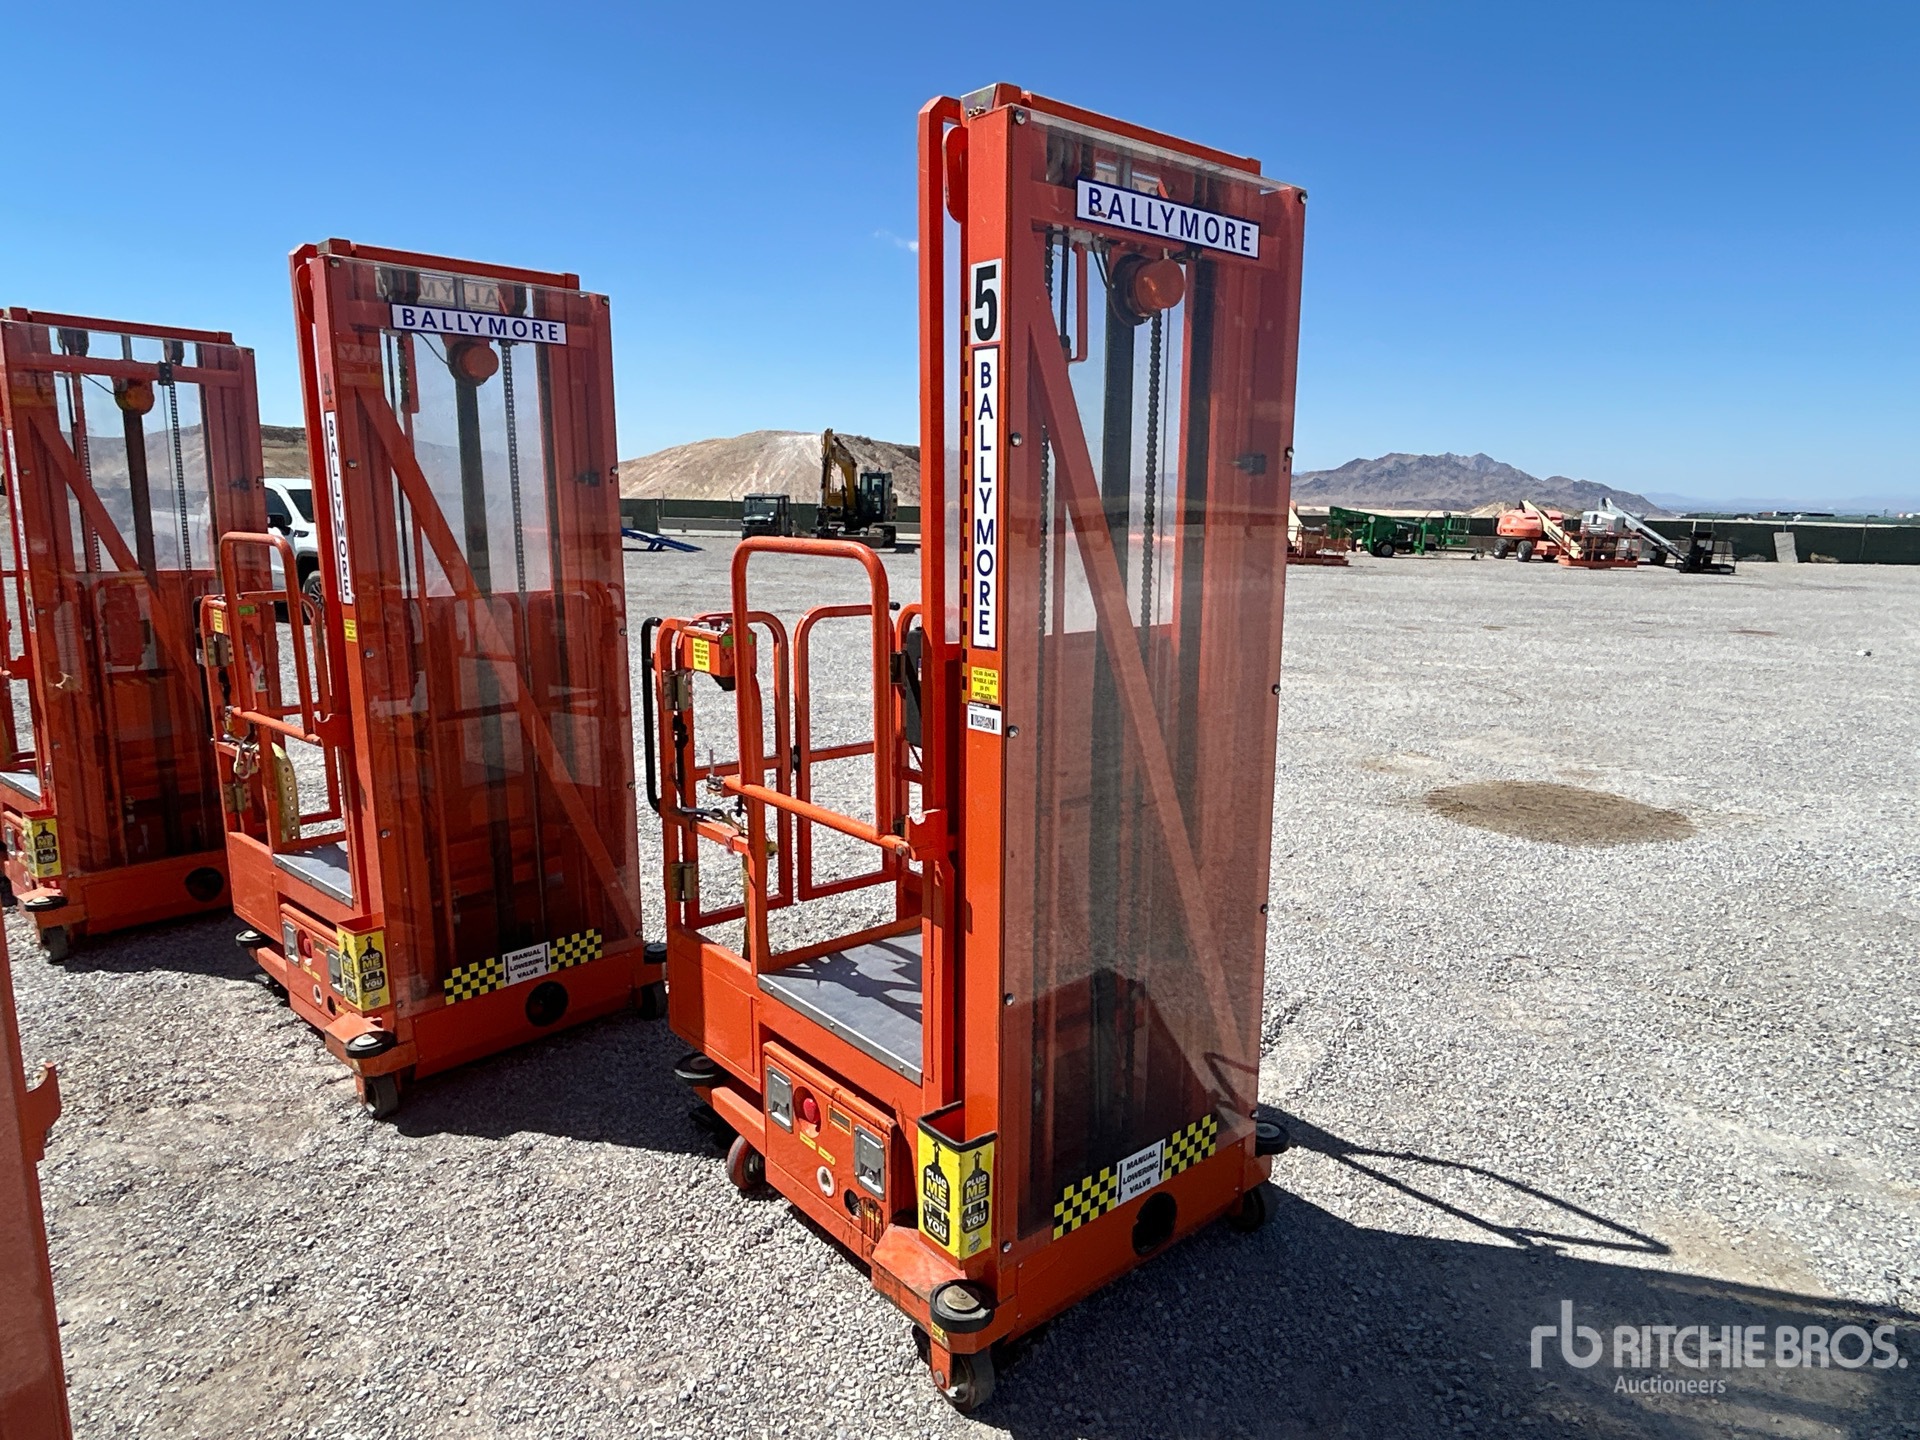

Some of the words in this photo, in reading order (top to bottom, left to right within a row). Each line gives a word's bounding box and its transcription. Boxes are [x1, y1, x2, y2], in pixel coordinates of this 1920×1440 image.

[1088, 187, 1251, 252] BALLYMORE
[975, 265, 998, 341] 5
[402, 308, 559, 341] BALLYMORE
[328, 420, 350, 596] BALLYMORE
[976, 362, 994, 636] BALLYMORE
[362, 958, 380, 969] ME
[510, 957, 544, 971] LOWERING
[512, 949, 541, 961] MANUAL
[517, 967, 538, 978] VALVE
[365, 978, 383, 988] YOU
[1127, 1150, 1156, 1170] MANUAL
[926, 1168, 947, 1189] PLUG
[966, 1174, 987, 1188] PLUG
[1123, 1160, 1158, 1185] LOWERING
[926, 1177, 947, 1201] ME
[966, 1181, 987, 1199] ME
[1129, 1177, 1151, 1194] VALVE
[926, 1215, 947, 1238] YOU
[966, 1212, 986, 1227] YOU
